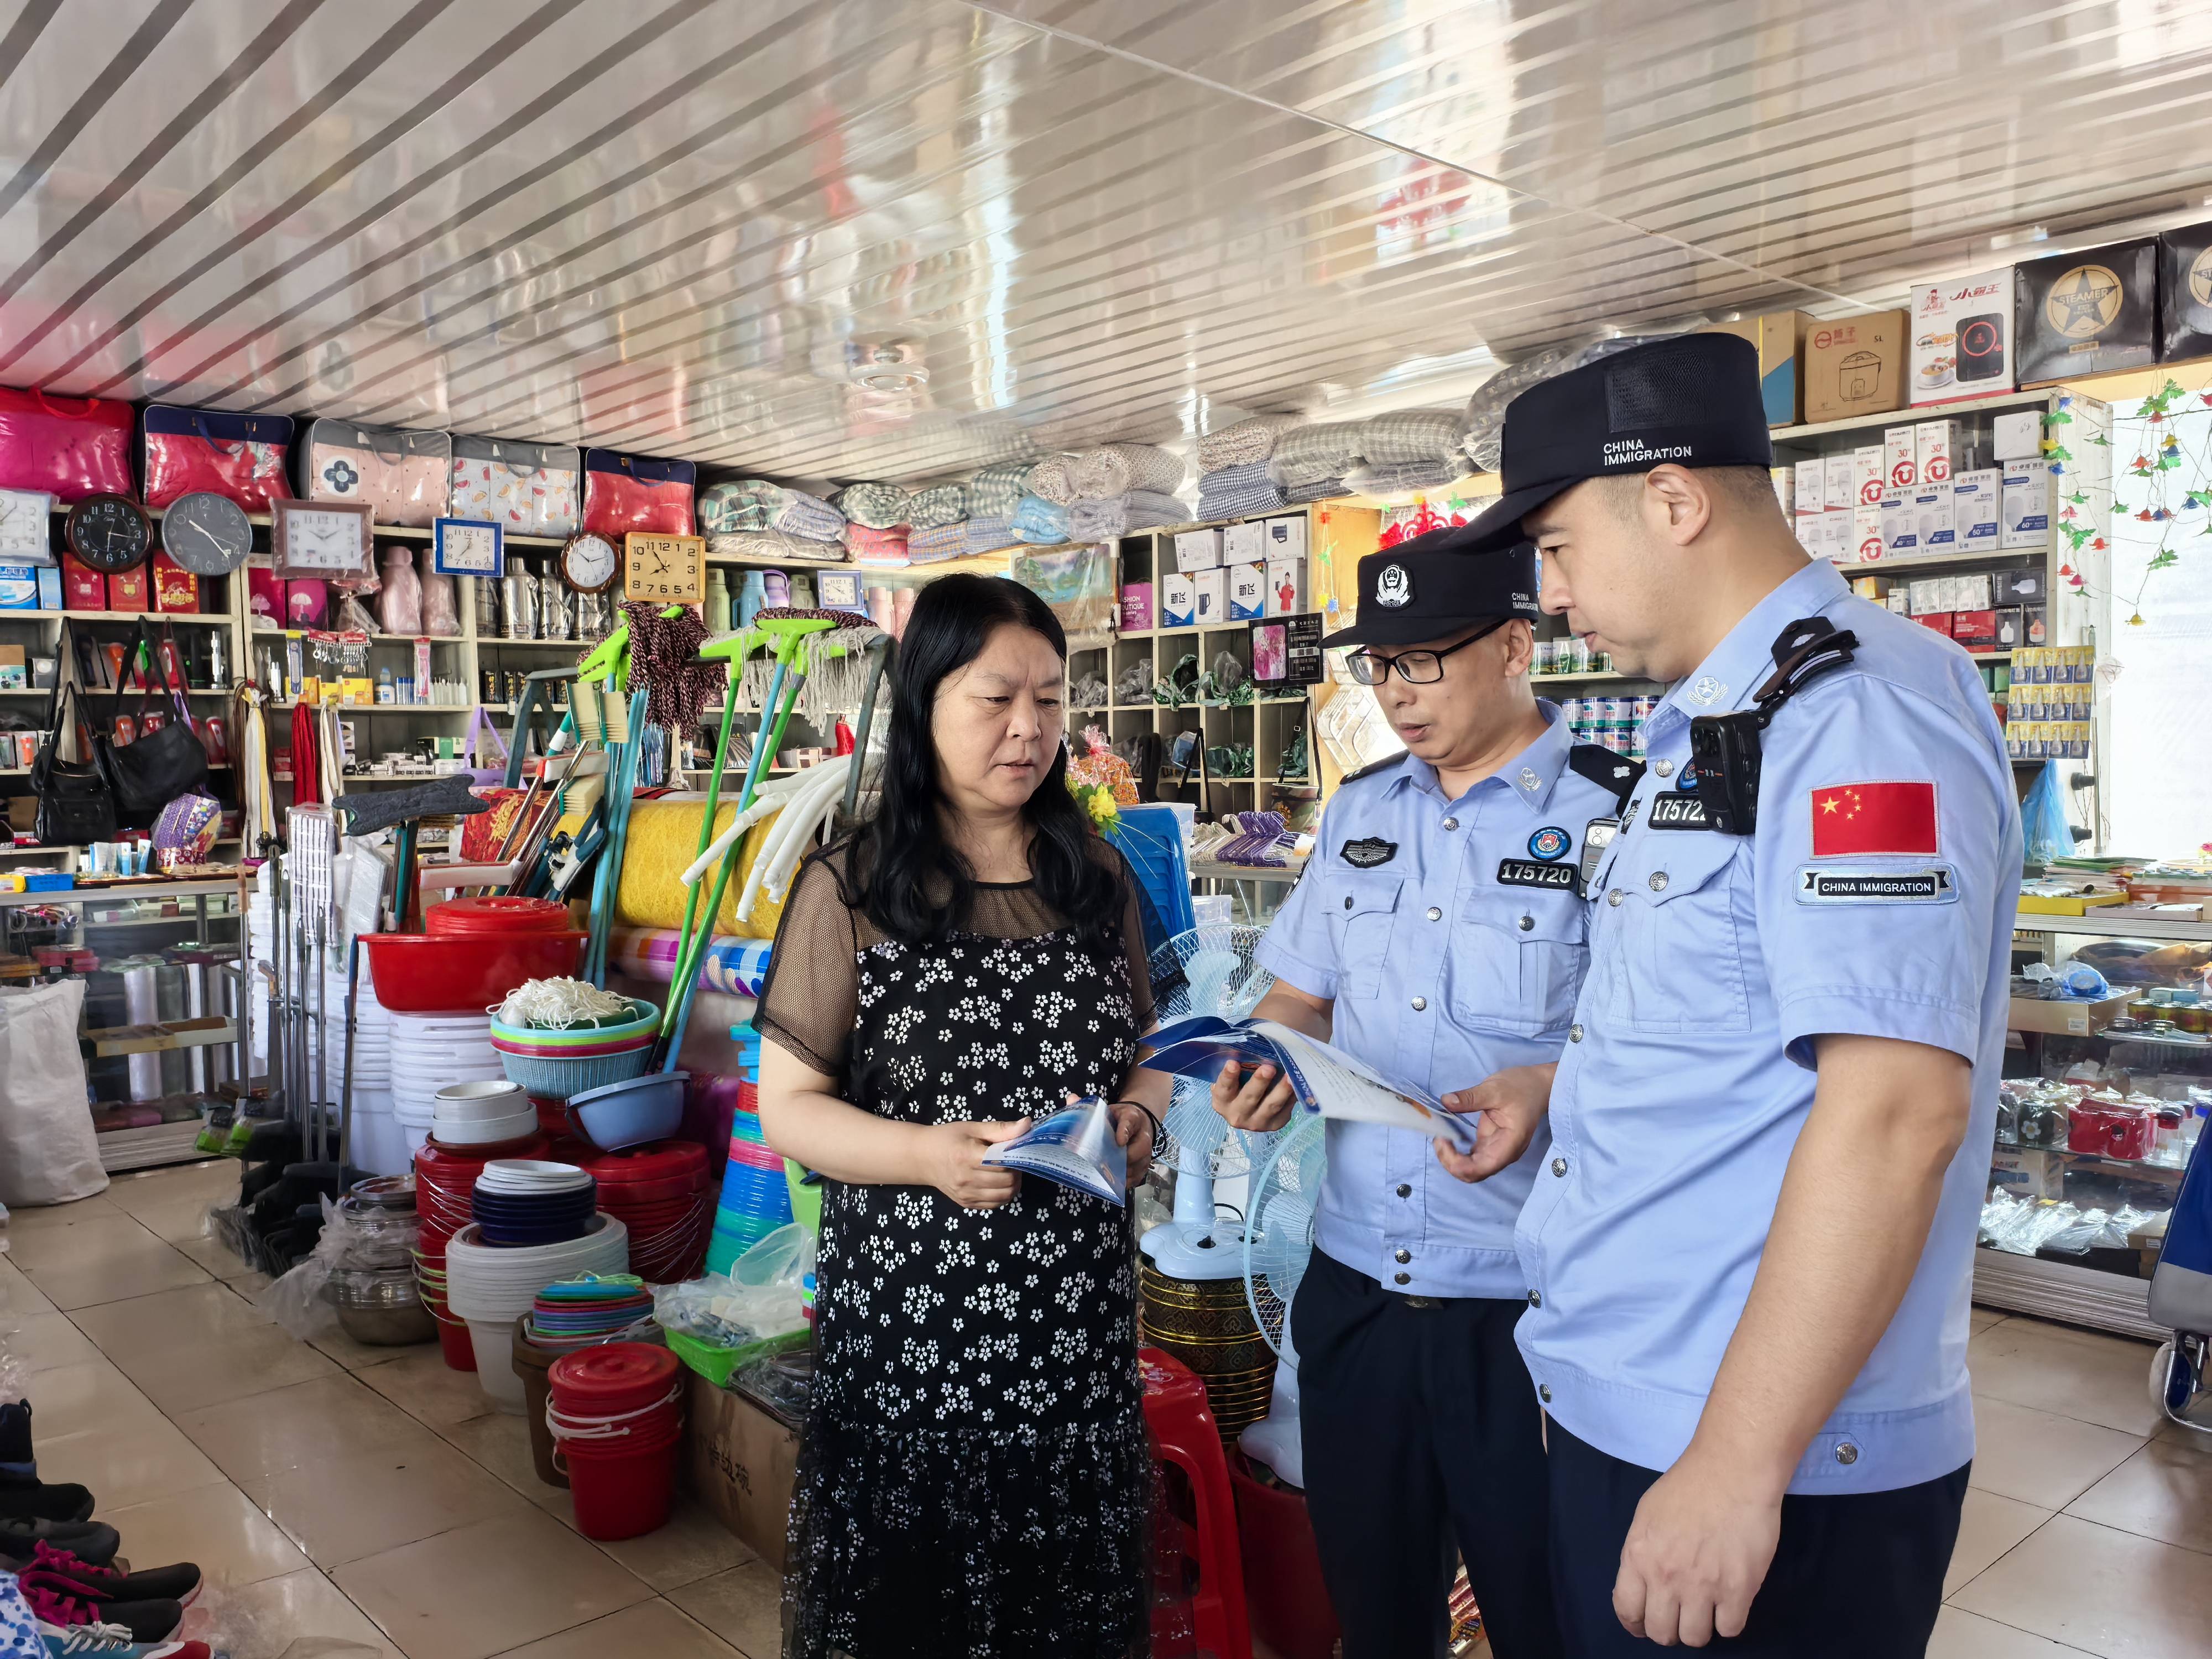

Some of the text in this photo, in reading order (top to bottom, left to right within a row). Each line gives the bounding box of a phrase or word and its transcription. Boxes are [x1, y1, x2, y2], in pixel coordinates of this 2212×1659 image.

[2059, 289, 2108, 304] STEAMER
[1604, 439, 1644, 454] CHINA
[1604, 446, 1692, 466] IMMIGRATION
[199, 498, 210, 509] 12
[91, 507, 98, 515] 11
[105, 504, 114, 513] 12
[122, 508, 125, 517] 1
[185, 503, 194, 514] 11
[83, 515, 91, 524] 10
[130, 517, 137, 525] 2
[230, 514, 239, 525] 2
[77, 527, 84, 535] 9
[238, 529, 245, 540] 3
[82, 540, 89, 549] 8
[130, 543, 136, 551] 4
[646, 542, 654, 550] 11
[658, 542, 670, 551] 12
[676, 544, 680, 552] 1
[92, 550, 98, 558] 7
[175, 544, 183, 555] 8
[234, 545, 241, 555] 4
[633, 546, 644, 555] 10
[687, 548, 695, 556] 2
[106, 554, 113, 562] 6
[121, 551, 127, 560] 5
[190, 555, 197, 565] 7
[206, 560, 214, 570] 6
[633, 562, 640, 571] 9
[687, 566, 695, 574] 3
[633, 581, 640, 589] 8
[646, 584, 654, 592] 7
[660, 585, 667, 593] 6
[674, 585, 681, 593] 5
[687, 583, 695, 592] 4
[1239, 583, 1255, 596] 新飞
[1171, 592, 1186, 604] 新飞
[1512, 592, 1529, 602] CHINA
[1501, 863, 1572, 884] 175720
[1822, 883, 1931, 892] CHINA IMMIGRATION
